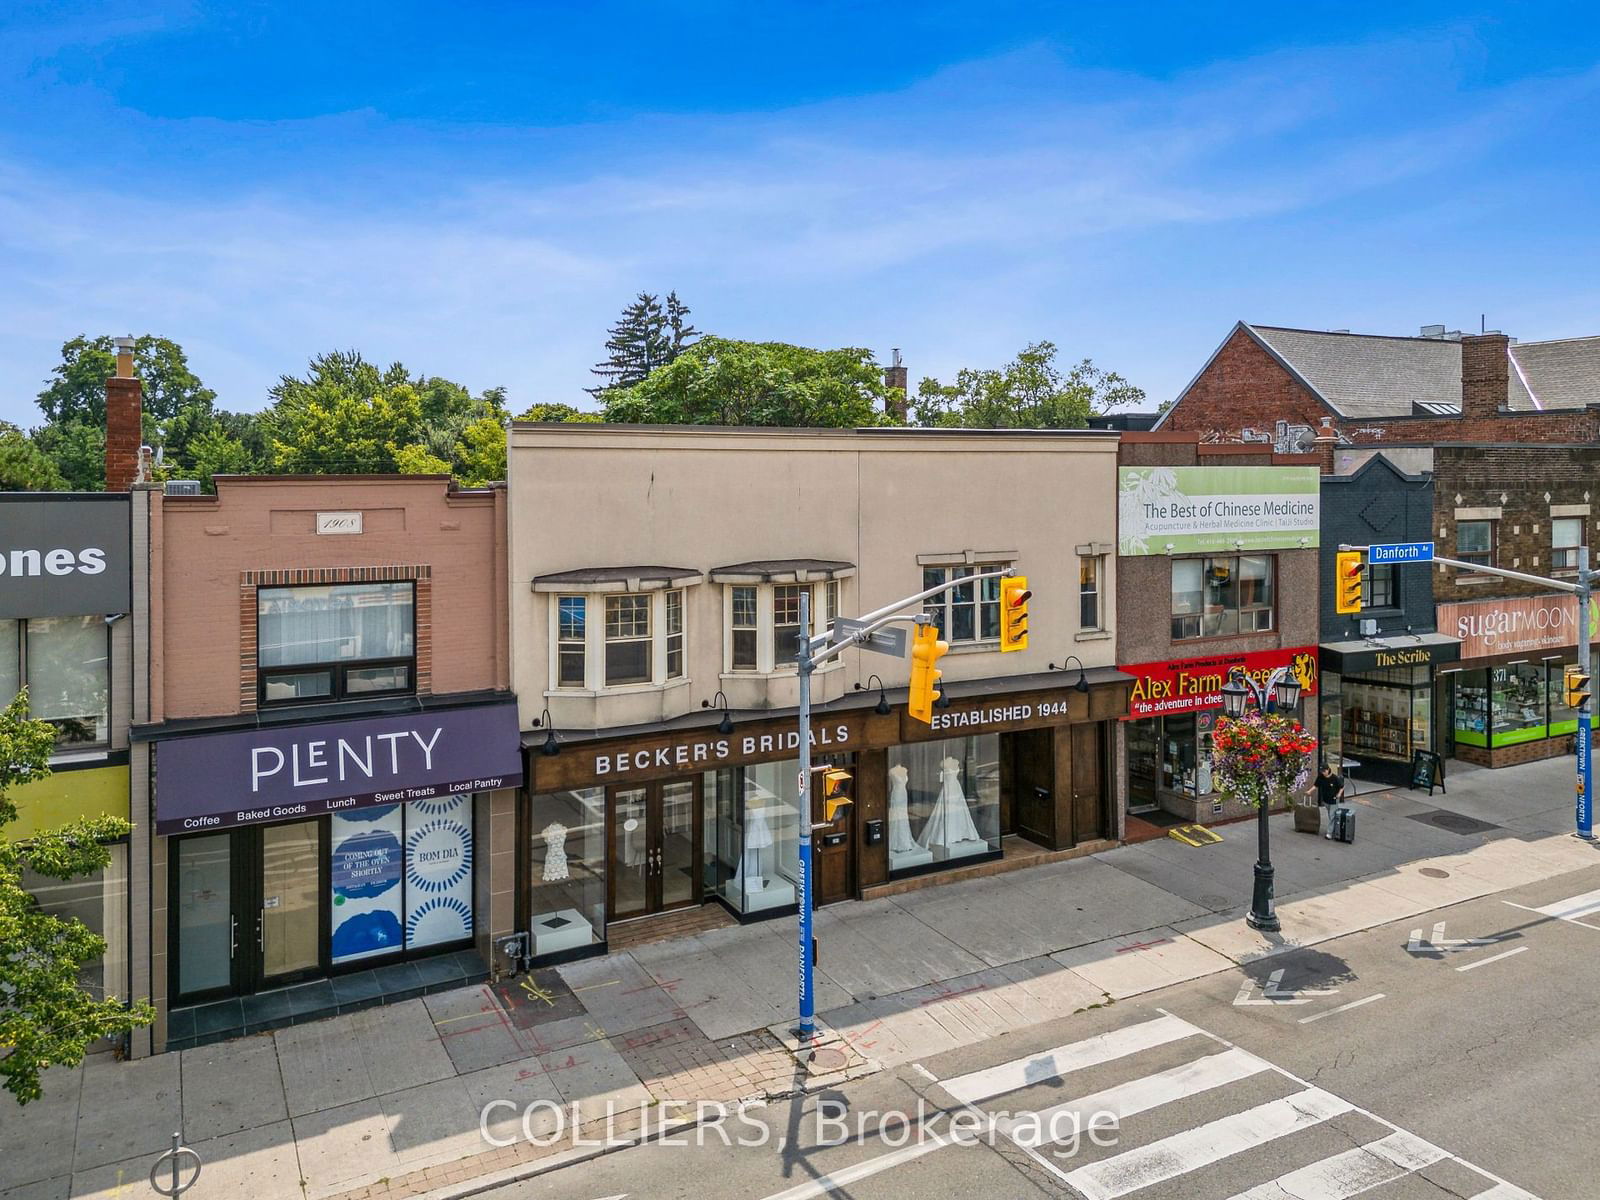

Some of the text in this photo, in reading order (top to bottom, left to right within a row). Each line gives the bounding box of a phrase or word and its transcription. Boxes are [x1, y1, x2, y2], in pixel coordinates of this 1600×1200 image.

[1144, 500, 1315, 519] The Best of Chinese Medicine
[1145, 521, 1191, 533] Acupuncture
[1192, 520, 1198, 529] &
[1199, 519, 1222, 529] Herbal
[1223, 519, 1254, 529] Medicine
[1255, 518, 1273, 528] Clinic
[1293, 517, 1314, 527] Studio
[1376, 546, 1419, 559] Danforth
[0, 547, 107, 577] nes
[1457, 606, 1575, 646] sugarMOON
[1376, 649, 1431, 667] The Scribe
[1493, 668, 1507, 683] 371
[1130, 675, 1172, 702] Alex
[1178, 671, 1222, 697] Farm
[1154, 697, 1193, 711] adventure
[1195, 695, 1202, 705] in
[931, 701, 1068, 730] ESTABLISHED 1944
[596, 725, 849, 776] BECKER'S BRIDALS
[251, 727, 443, 793] PLENTY
[449, 777, 503, 793] Local Pantry
[374, 786, 436, 803] Sweet Treats
[326, 797, 356, 810] Lunch
[237, 803, 307, 822] Baked Goods
[184, 815, 221, 829] Coffee
[344, 850, 374, 861] COMING
[420, 850, 440, 863] BOM
[442, 847, 459, 860] DIA
[343, 862, 354, 870] OF
[355, 859, 371, 869] THE
[351, 866, 383, 879] SHORTLY
